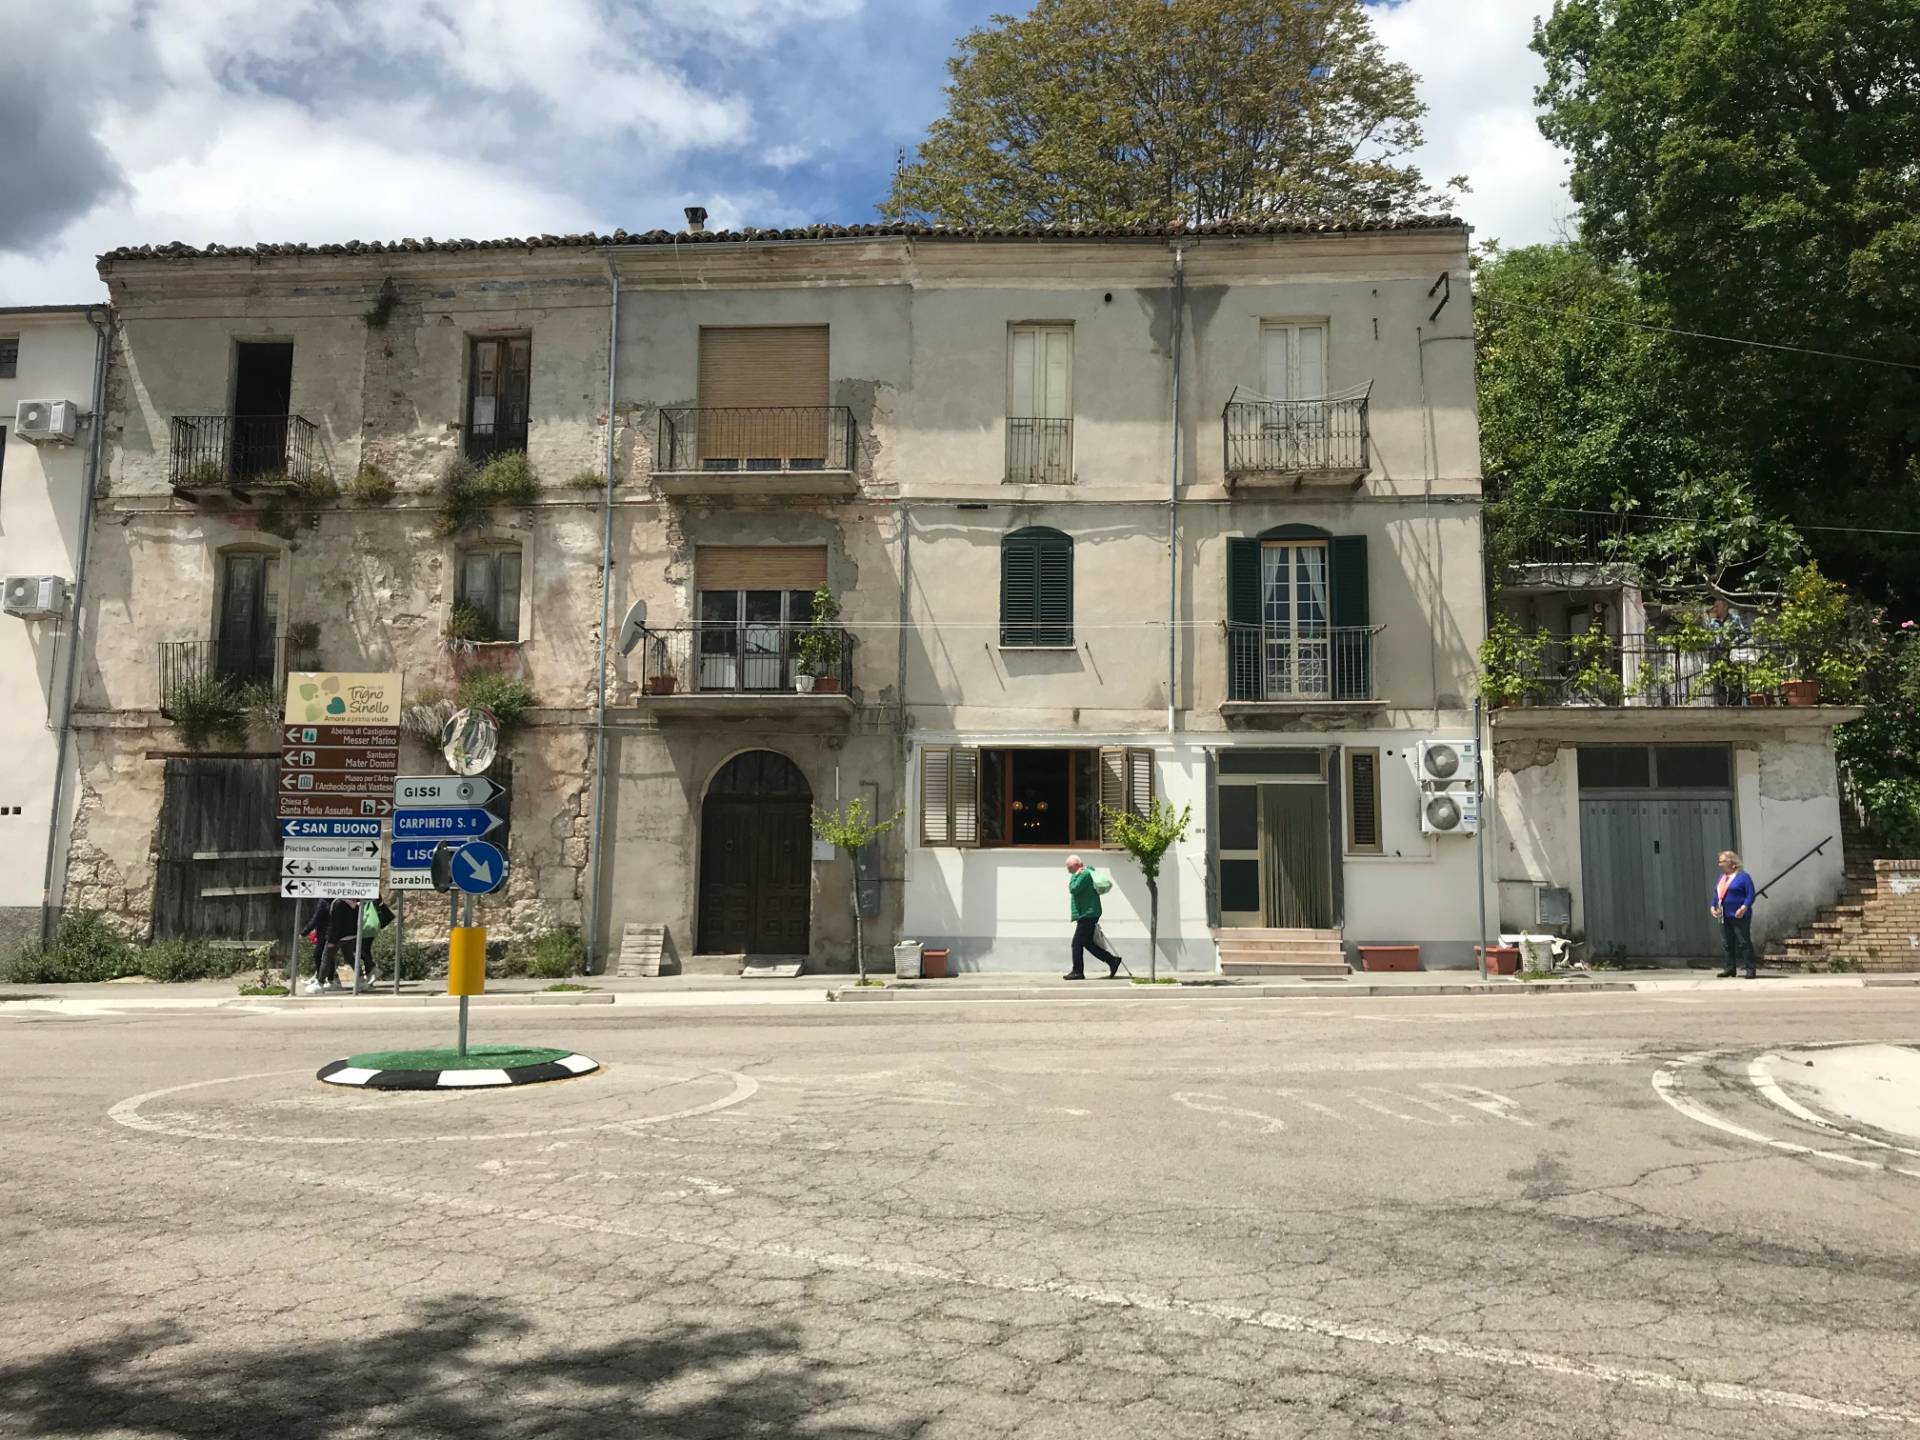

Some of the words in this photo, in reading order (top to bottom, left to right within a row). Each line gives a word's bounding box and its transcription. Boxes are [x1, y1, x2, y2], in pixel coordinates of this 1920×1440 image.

[348, 686, 384, 704] Trigno
[350, 700, 389, 714] Sinello
[362, 728, 397, 737] Castiglione
[343, 736, 370, 745] Messer
[371, 737, 397, 745] Marino
[366, 751, 396, 759] Santuario
[345, 759, 368, 768] Mater
[369, 760, 395, 768] Domini
[357, 783, 367, 791] del
[404, 787, 441, 798] GISSI
[280, 798, 301, 806] Chiesa
[280, 806, 300, 815] Santa
[302, 807, 323, 815] Maria
[324, 806, 353, 815] Assunta
[399, 818, 453, 829] CARPINETO
[457, 817, 467, 829] S.
[301, 823, 328, 834] SAN
[333, 823, 379, 834] BUONO
[285, 845, 310, 854] Piscina
[311, 845, 347, 853] Comunale
[407, 848, 435, 860] LISC
[318, 864, 350, 872] carabinieri
[352, 864, 378, 872] forestali
[391, 875, 432, 885] carabin
